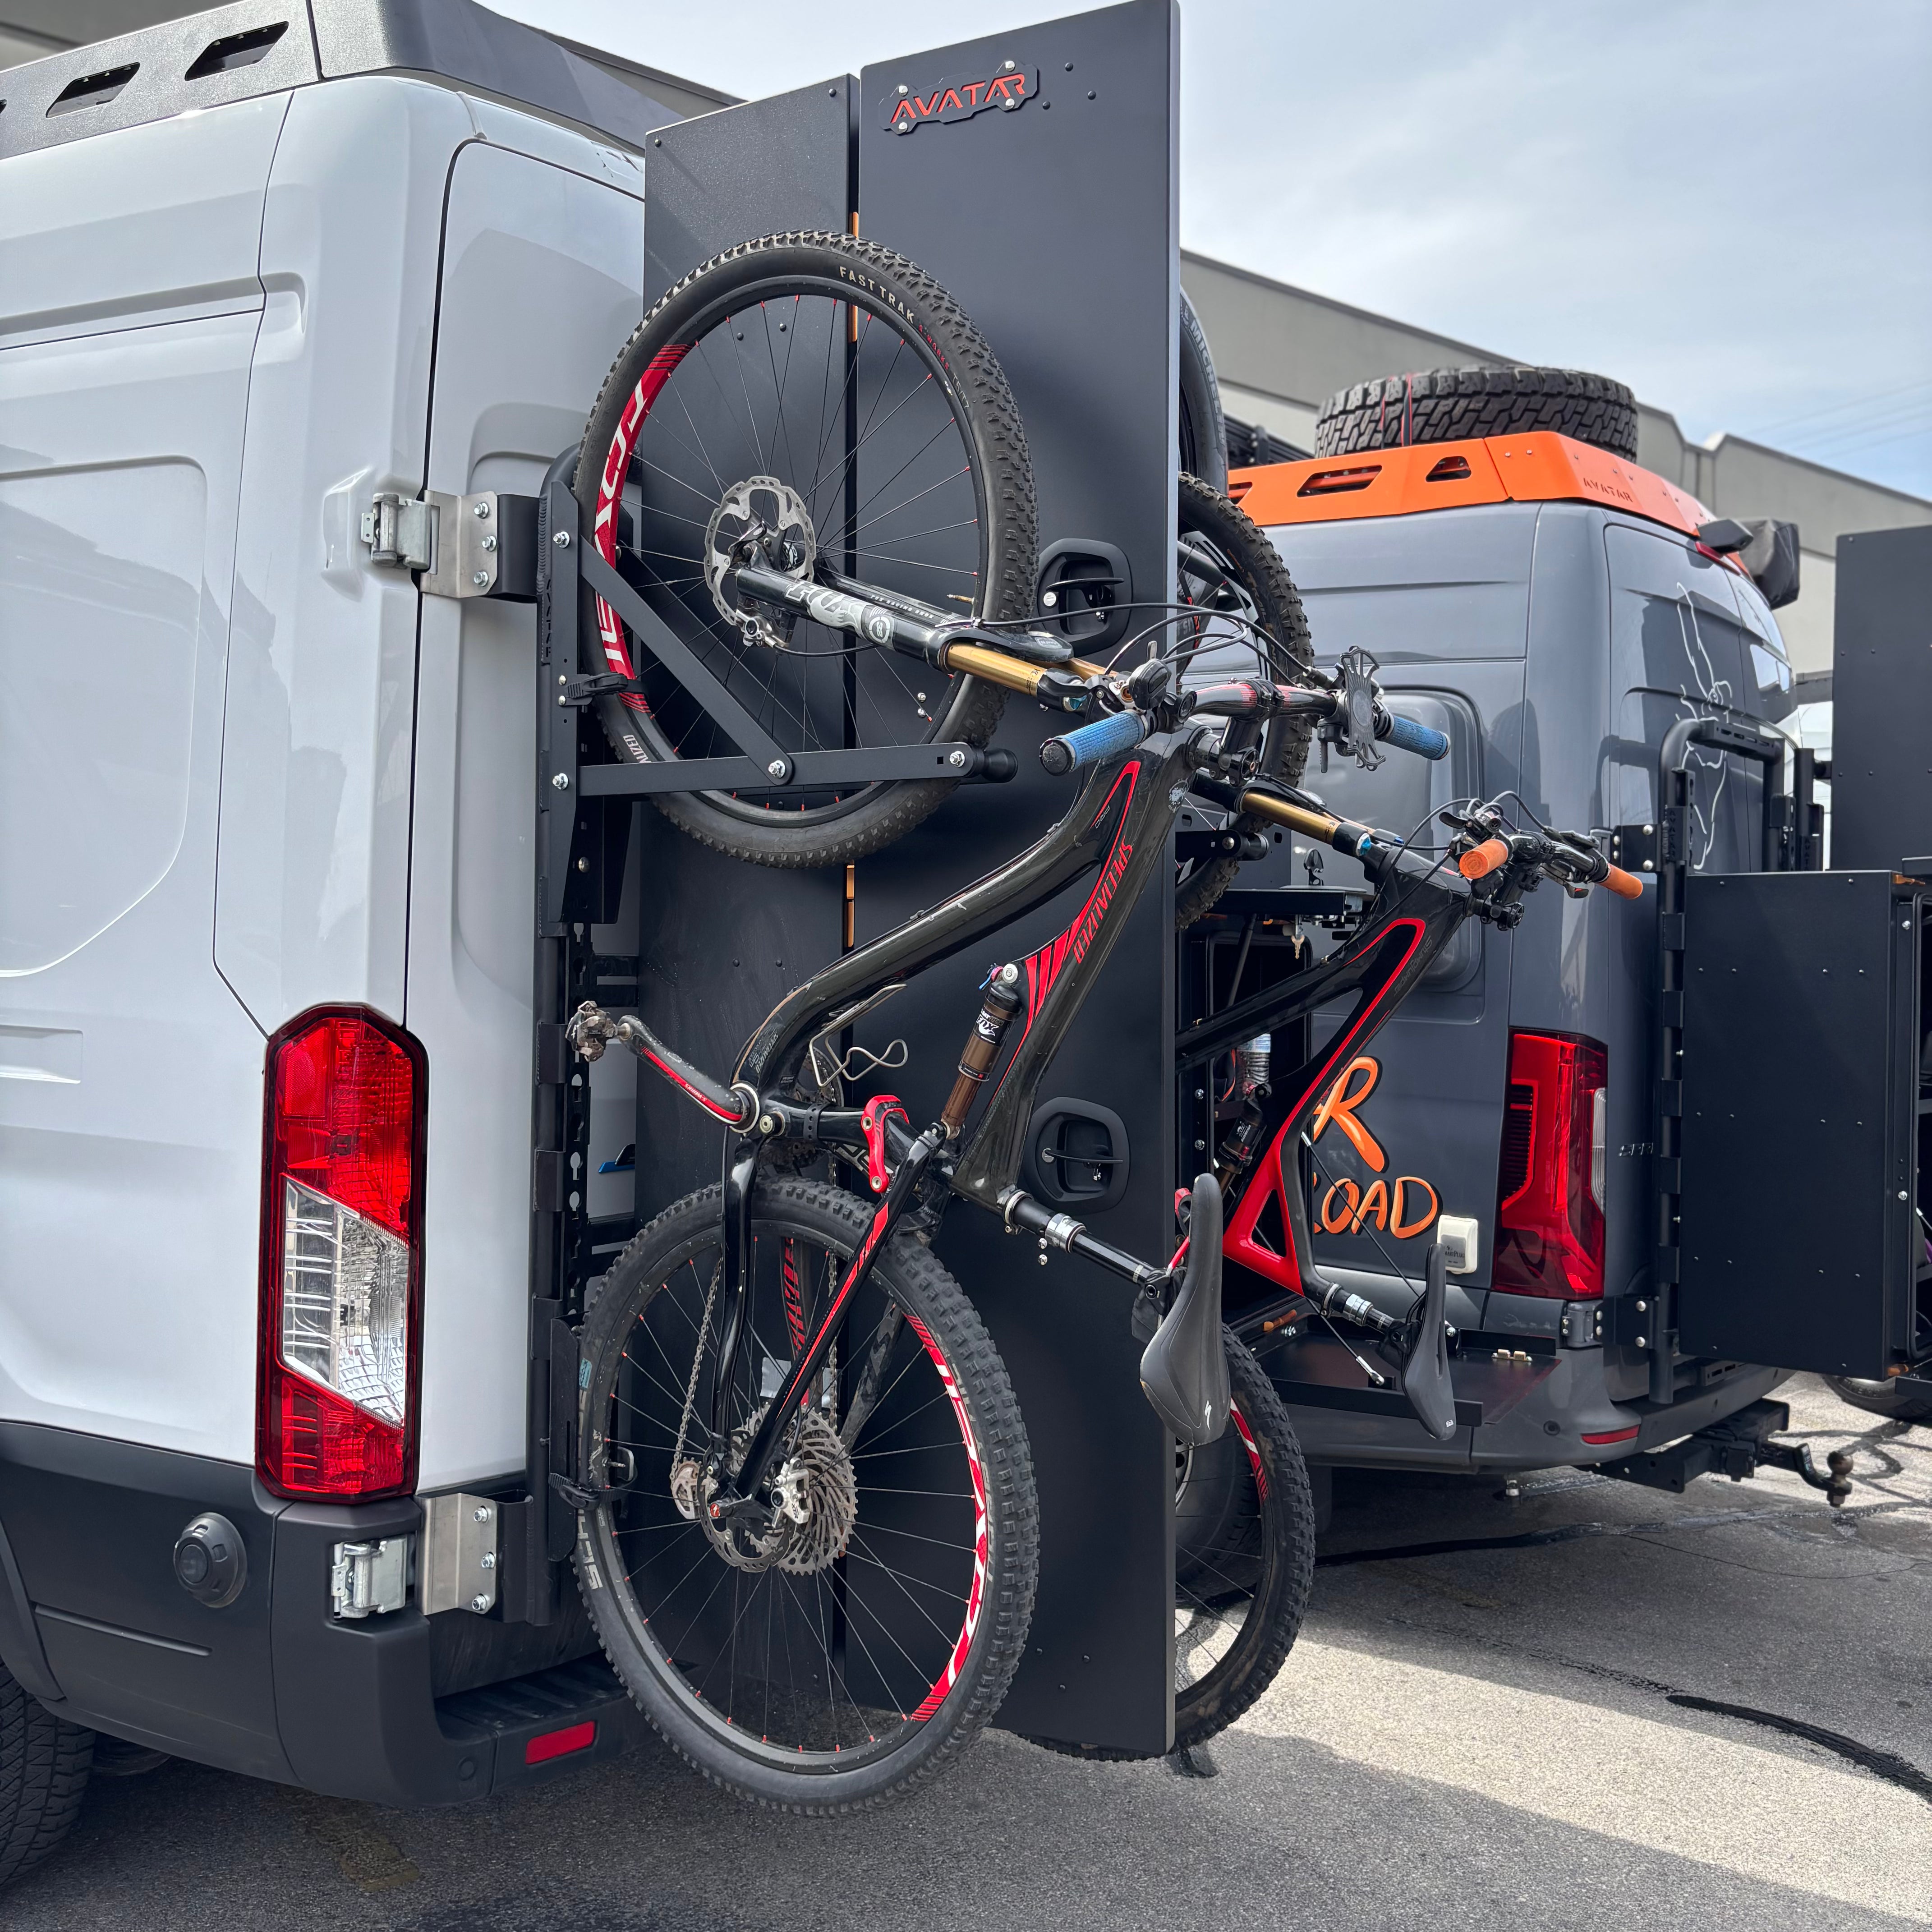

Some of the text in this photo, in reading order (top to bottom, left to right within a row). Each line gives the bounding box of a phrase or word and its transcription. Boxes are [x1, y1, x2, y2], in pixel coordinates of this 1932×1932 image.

[890, 73, 1026, 124] AVATAR
[839, 266, 915, 324] FAST TRAK
[1189, 318, 1226, 447] MICHELIN
[1583, 478, 1633, 502] AVATAR
[1073, 835, 1133, 964] SPECIALIZED
[976, 1013, 999, 1037] FOX
[1314, 1173, 1438, 1239] OAD
